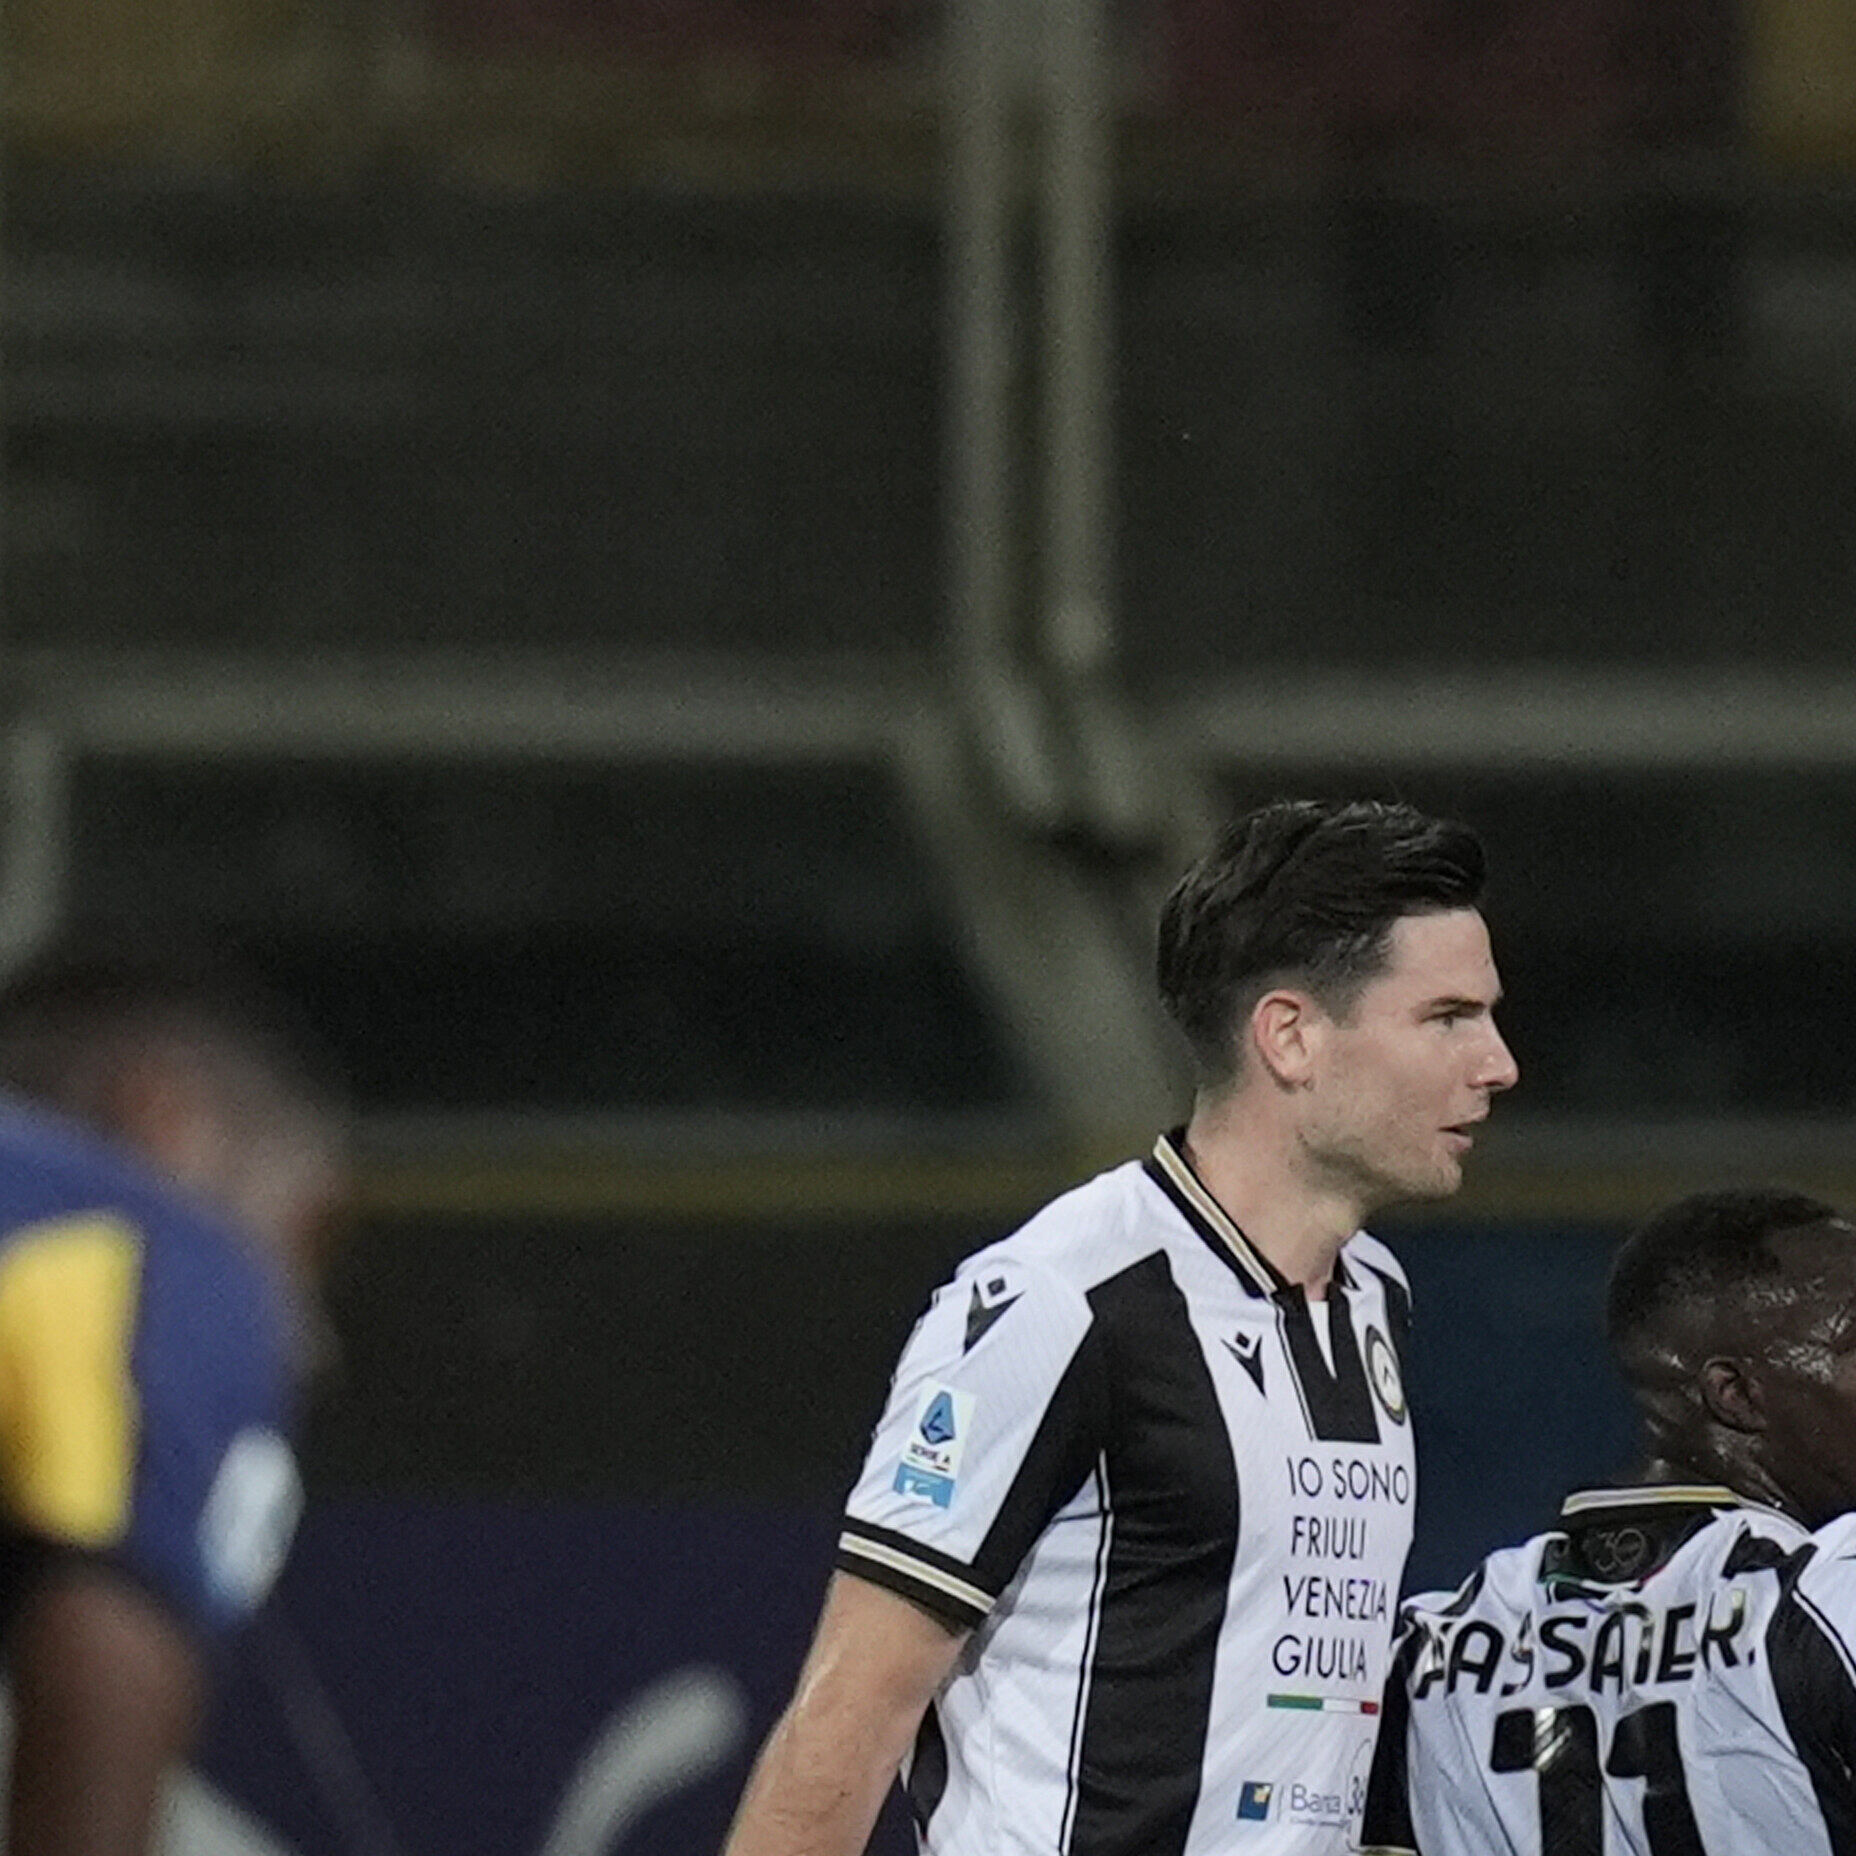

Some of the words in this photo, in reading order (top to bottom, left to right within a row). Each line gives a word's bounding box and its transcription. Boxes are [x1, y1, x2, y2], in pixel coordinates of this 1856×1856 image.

[1286, 1455, 1323, 1498] IO
[1332, 1458, 1409, 1505] SONO
[1291, 1514, 1367, 1559] FRIULI
[1283, 1574, 1388, 1623] VENEZIA
[1271, 1633, 1368, 1683] GIULIA
